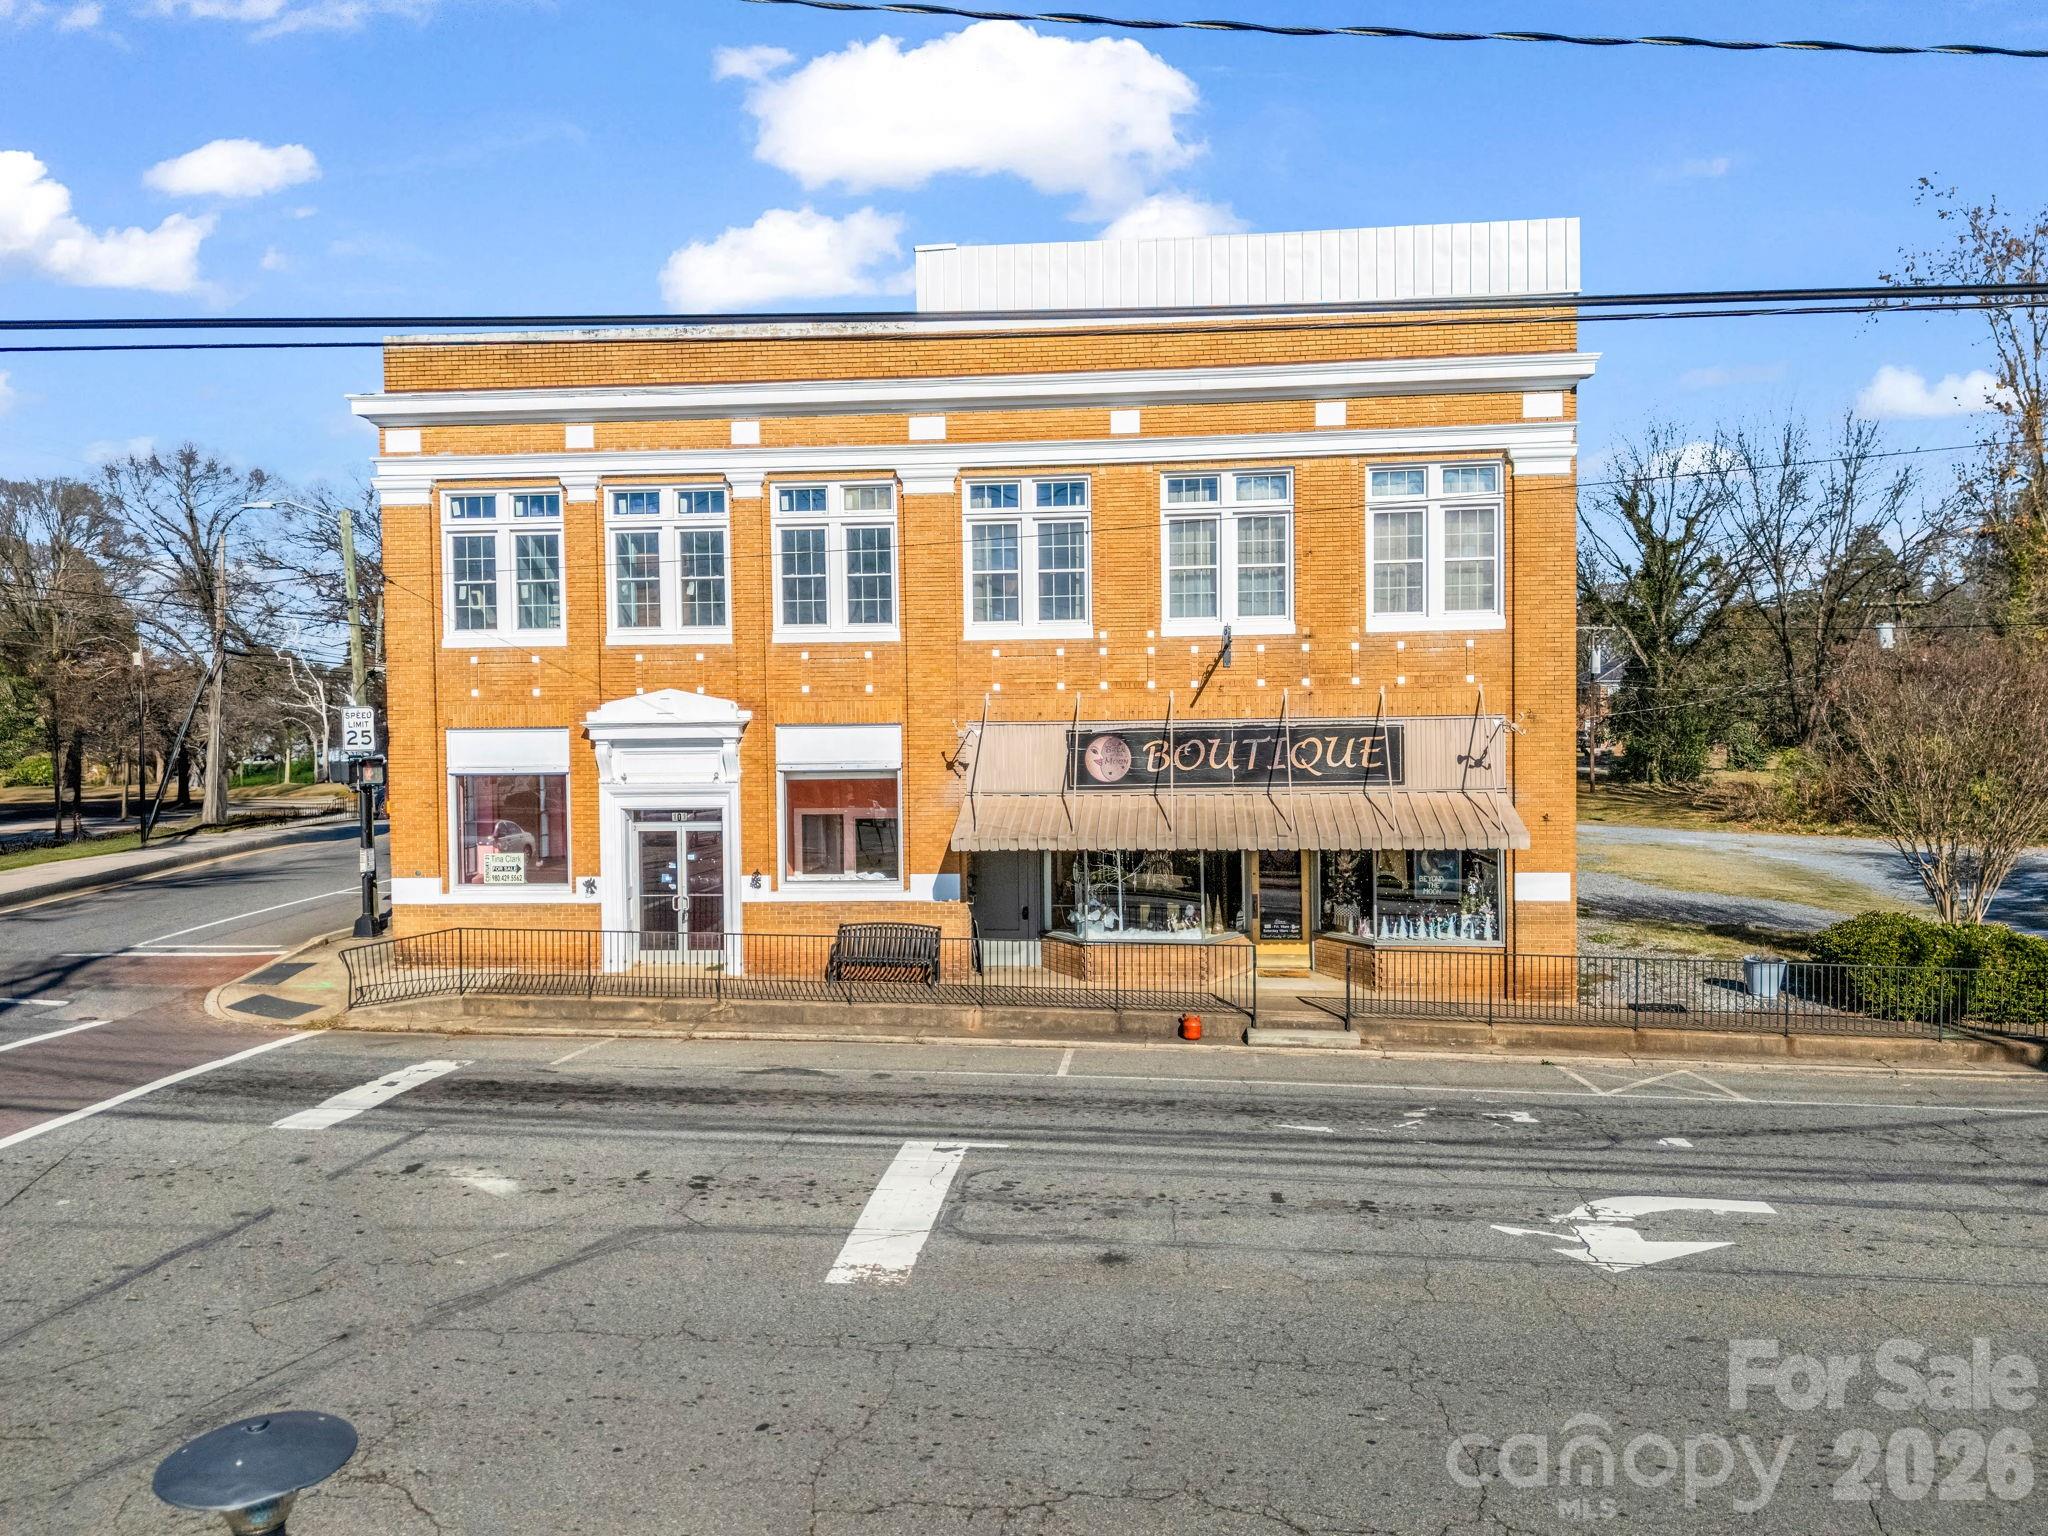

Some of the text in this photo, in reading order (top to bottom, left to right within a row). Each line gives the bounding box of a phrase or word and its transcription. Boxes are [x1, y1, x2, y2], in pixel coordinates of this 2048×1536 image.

[345, 711, 372, 719] SPEED
[346, 730, 372, 745] 25
[1143, 735, 1386, 776] BOUTIQUE
[505, 855, 521, 863] Clark
